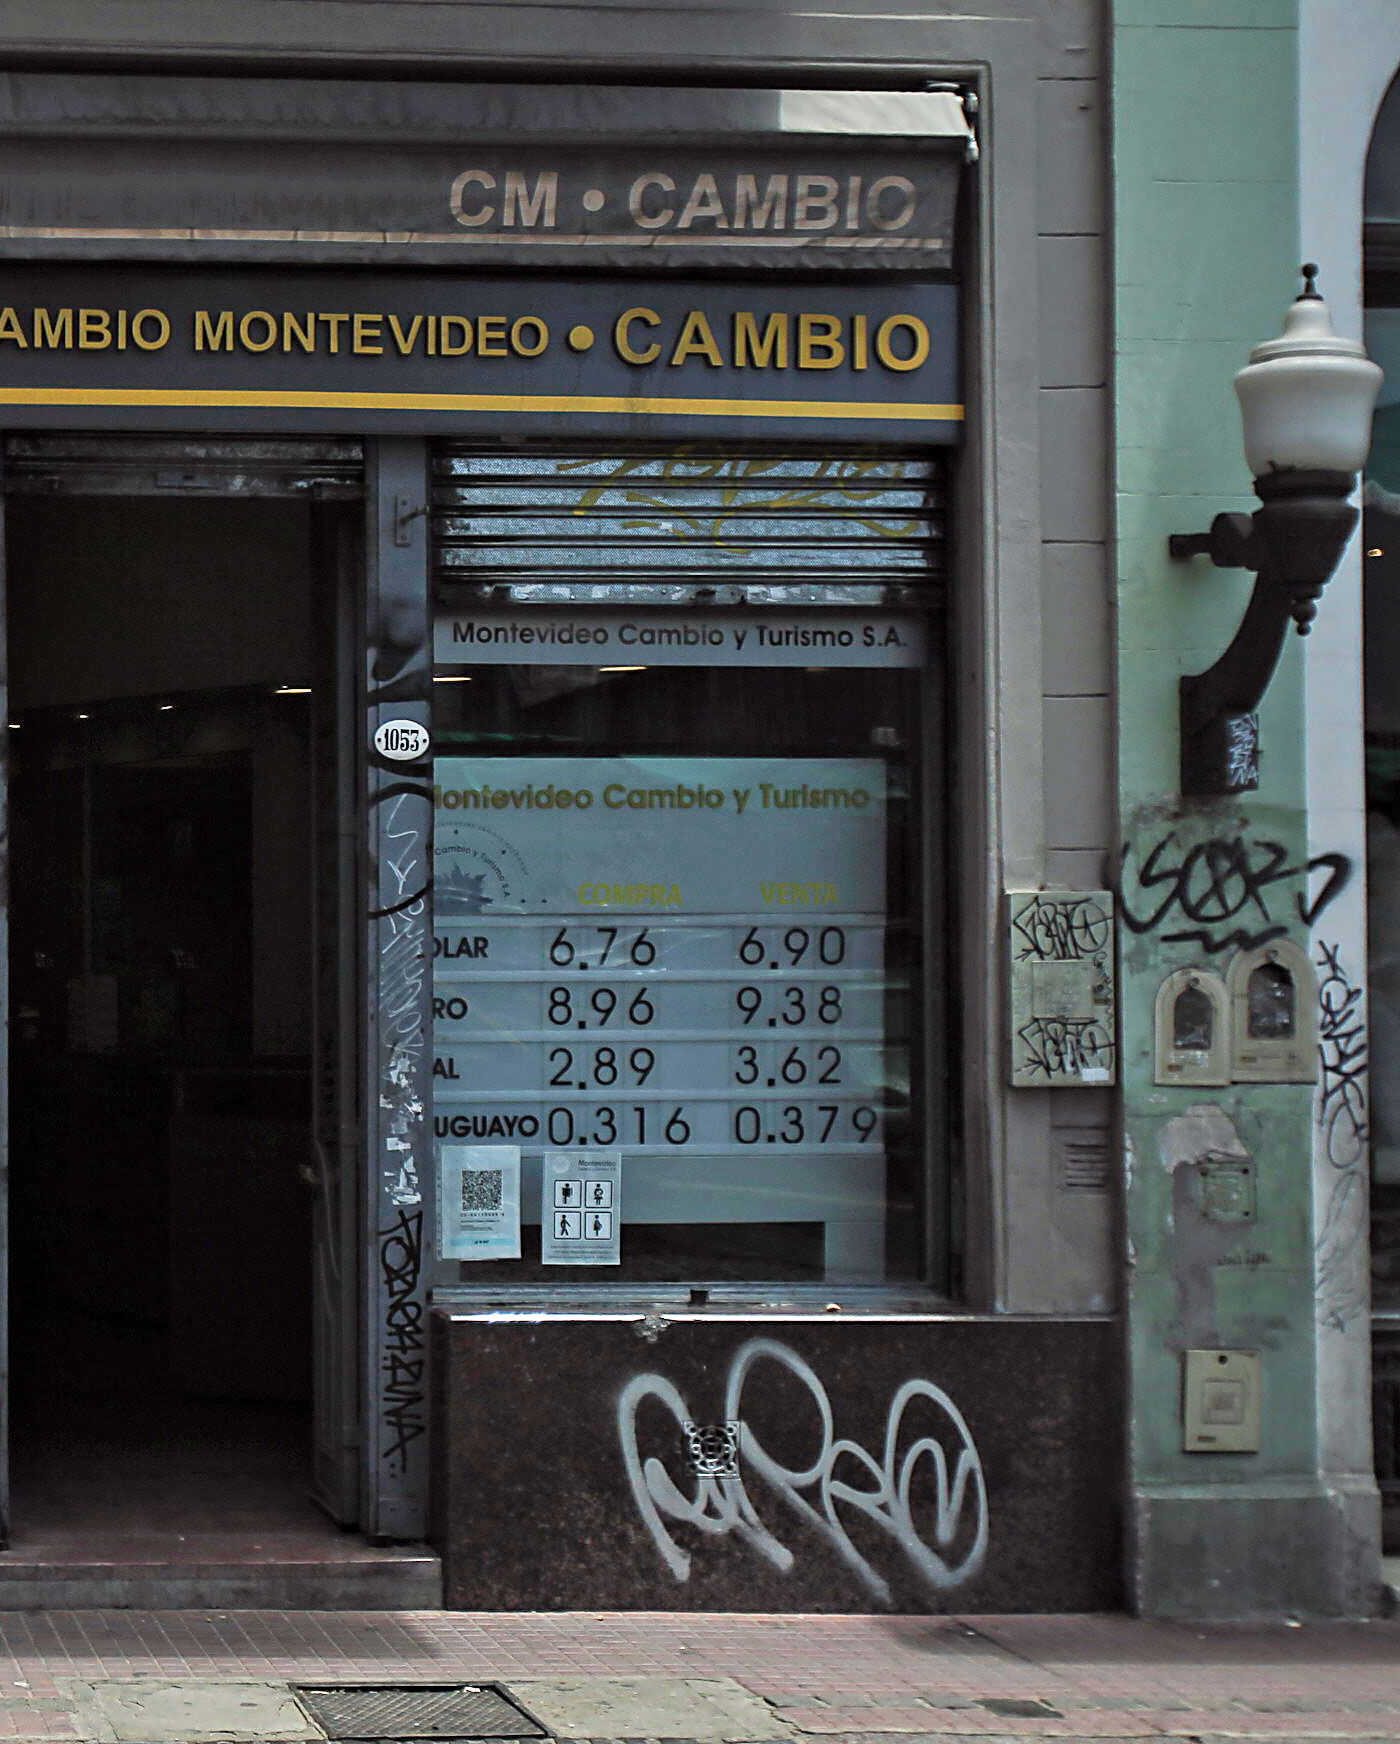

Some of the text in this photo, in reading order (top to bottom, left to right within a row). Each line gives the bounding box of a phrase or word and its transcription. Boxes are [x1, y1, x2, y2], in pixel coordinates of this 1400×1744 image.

[449, 170, 918, 230] CM CAMBIO
[195, 310, 550, 358] MONTEVIDEO
[614, 307, 931, 371] CAMBIO
[452, 622, 908, 651] Montevideo Cambio y Turismo S.A.
[383, 728, 421, 752] 1053
[434, 784, 872, 815] ontevideo Cambio y Turismo
[576, 881, 840, 907] COMPRA VENTA
[550, 927, 656, 971] 6.76
[739, 926, 846, 971] 6.90
[548, 986, 655, 1029] 8.96
[736, 985, 843, 1028] 9.38
[549, 1047, 656, 1091] 2.89
[735, 1046, 843, 1088] 3.62
[548, 1107, 691, 1146] 0.316
[735, 1106, 878, 1145] 0.379
